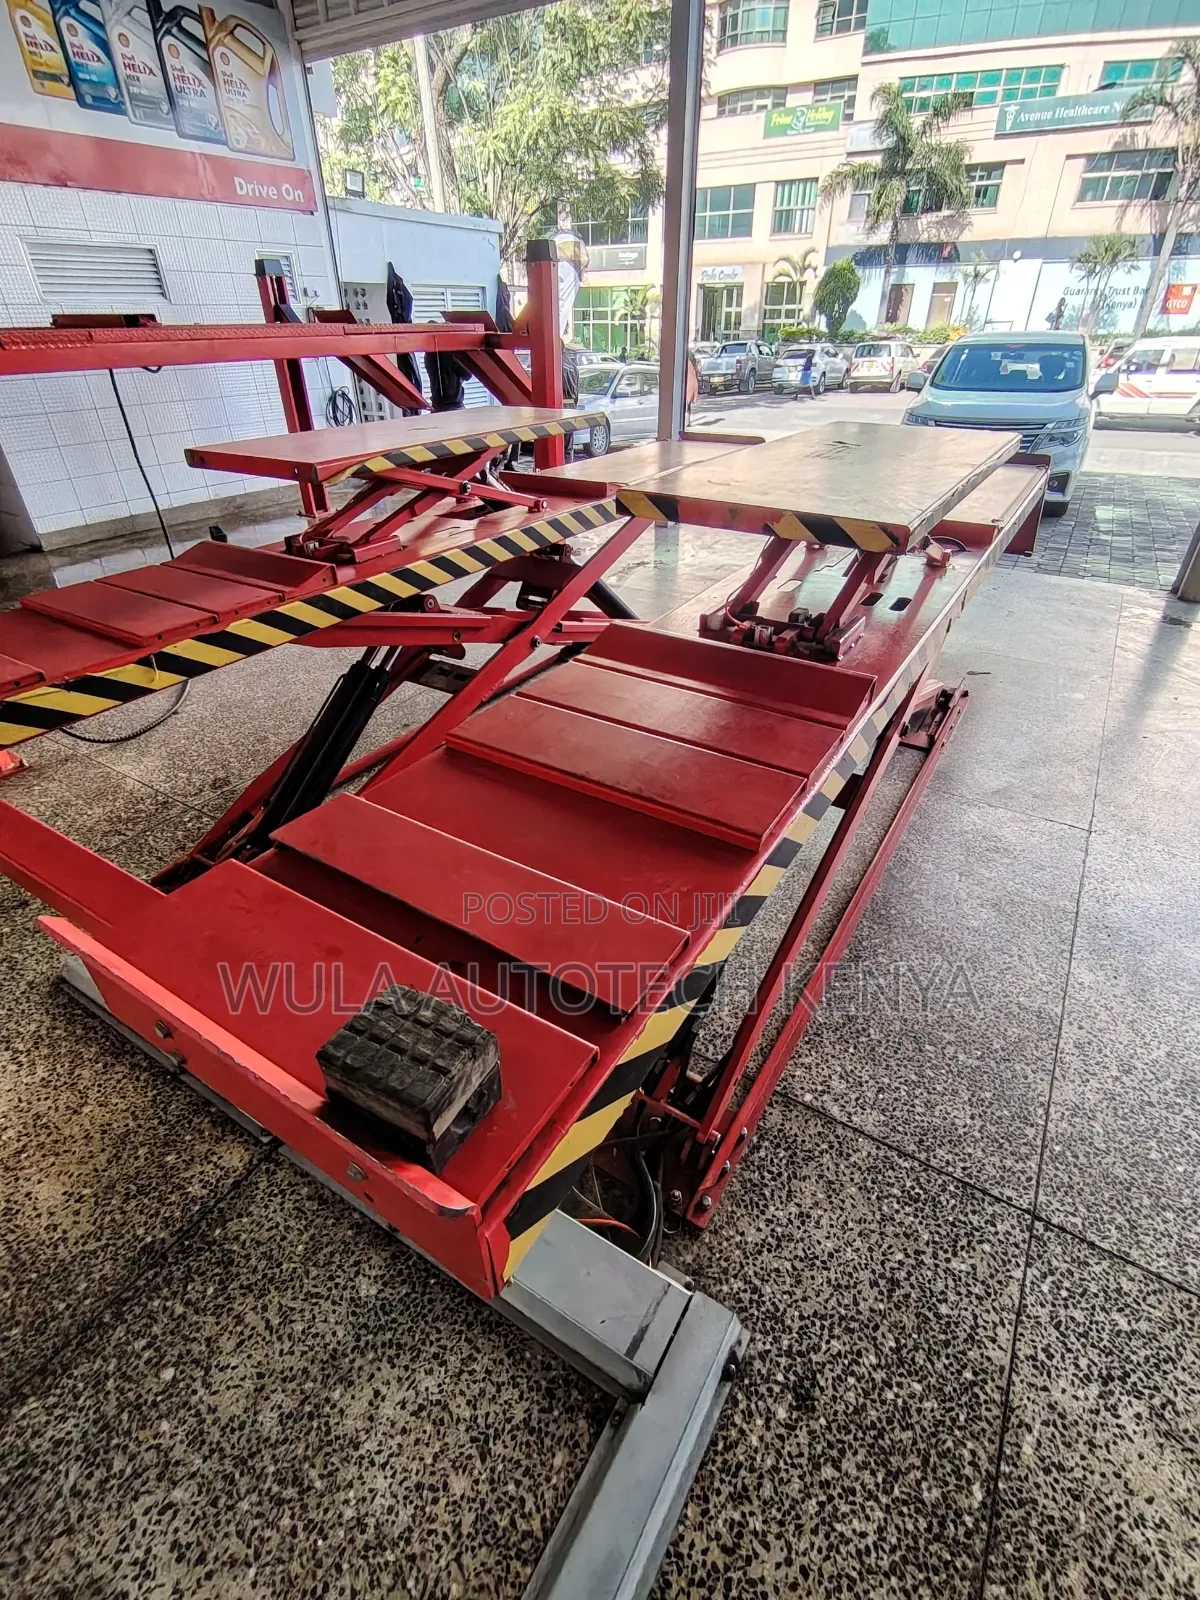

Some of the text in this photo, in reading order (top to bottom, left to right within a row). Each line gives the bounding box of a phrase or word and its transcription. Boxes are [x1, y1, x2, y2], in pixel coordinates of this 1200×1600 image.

[123, 61, 157, 77] HELIX
[172, 72, 207, 89] HELIX
[222, 78, 251, 92] HELIX
[174, 84, 207, 99] ULTRA
[224, 87, 248, 99] ULTRA
[1016, 111, 1052, 122] Avenue
[1055, 104, 1110, 118] Healthcare
[233, 176, 304, 202] Drive On
